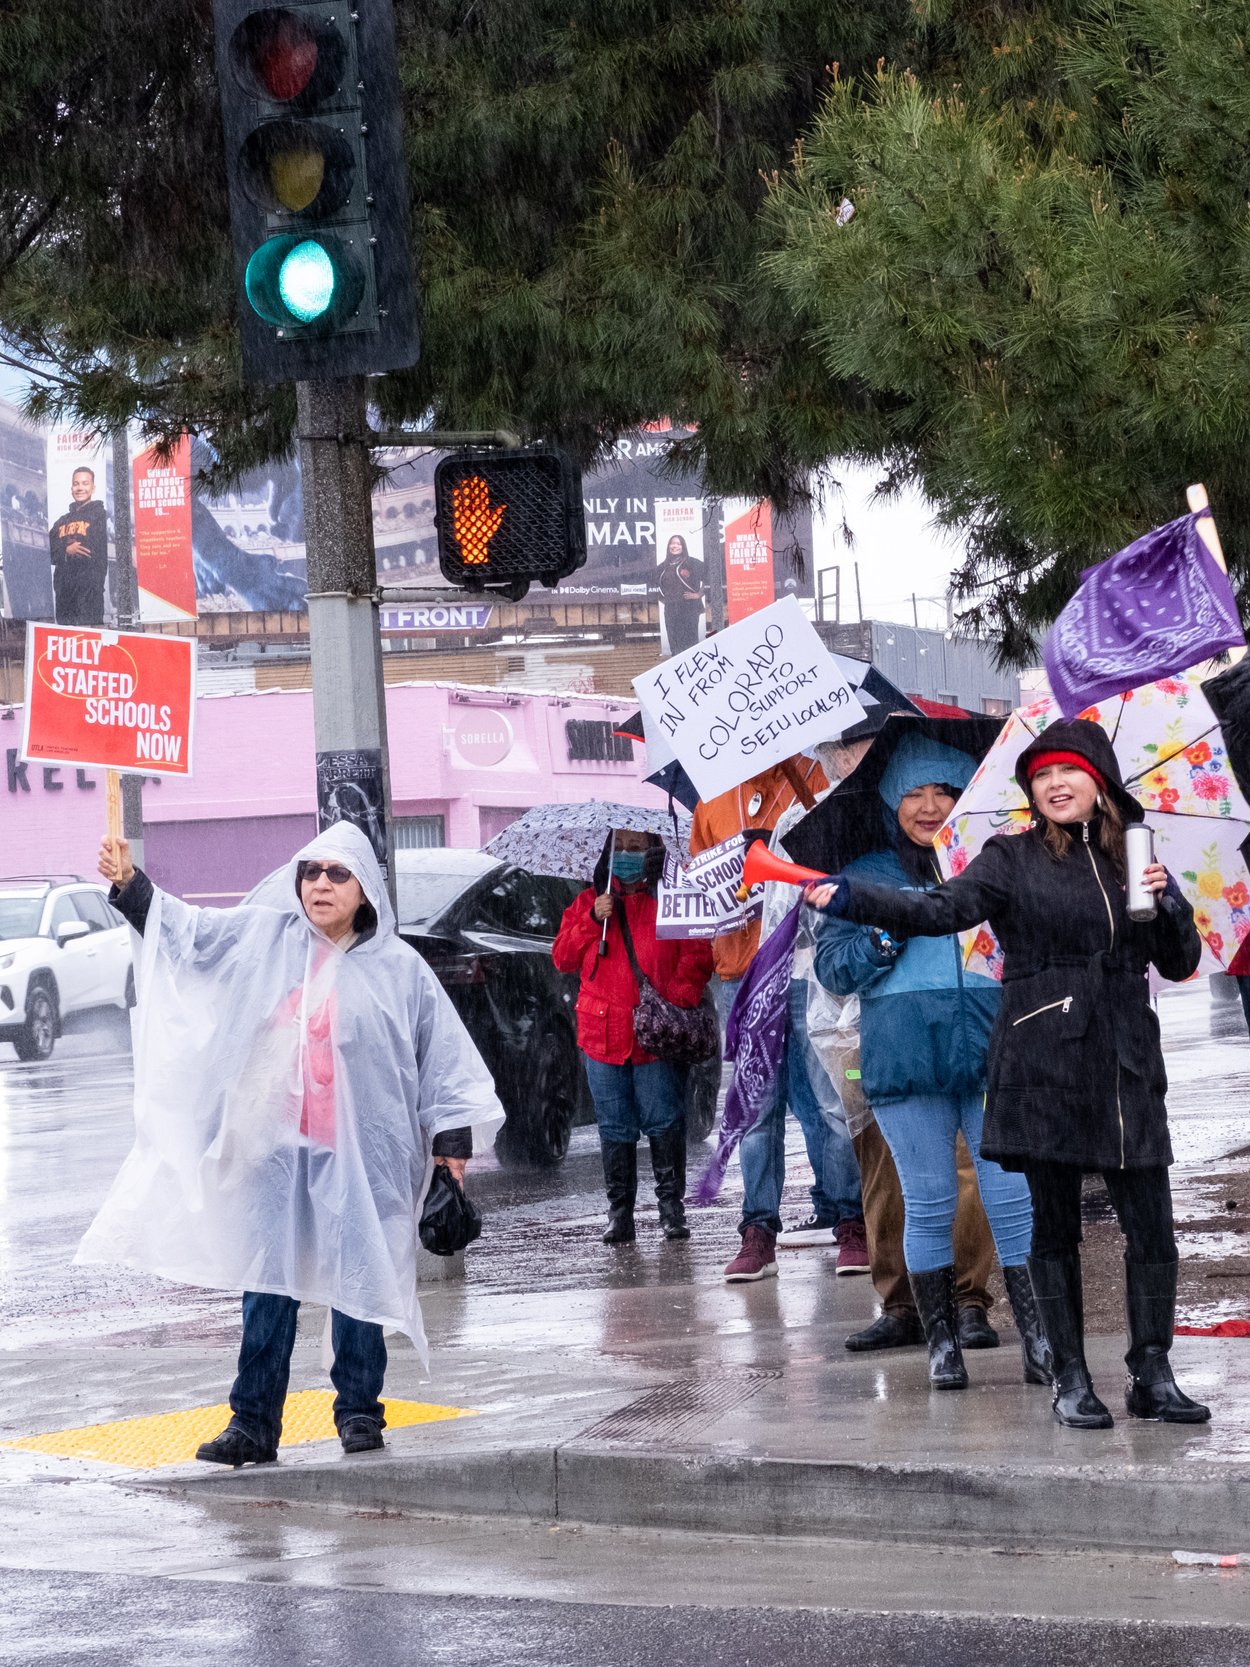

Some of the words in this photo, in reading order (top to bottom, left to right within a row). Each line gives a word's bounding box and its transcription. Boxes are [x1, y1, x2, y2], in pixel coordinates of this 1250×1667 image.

[138, 479, 157, 488] LOVE
[159, 477, 185, 487] ABOUT
[138, 486, 185, 500] FAIRFAX
[139, 500, 156, 508] HIGH
[158, 498, 185, 507] SCHOOL
[583, 498, 619, 513] NLY
[627, 497, 647, 513] IN
[663, 508, 694, 516] FAIRFAX
[587, 521, 656, 545] MAR
[730, 547, 767, 558] FAIRFAX
[570, 586, 590, 595] Dolby
[381, 607, 484, 627] TFRONT
[47, 636, 102, 665] FULLY
[52, 667, 132, 698] STAFFED
[653, 673, 670, 700] I
[674, 642, 719, 685] FLEW
[768, 662, 793, 683] TO
[659, 700, 686, 737] IN
[688, 656, 734, 706] FROM
[699, 624, 784, 760] COLORADO
[749, 664, 819, 721] SUPPORT
[85, 698, 171, 731] SCHOOLS
[741, 714, 791, 755] SEIU
[792, 698, 833, 726] LOCAL
[829, 686, 850, 707] 99
[136, 732, 181, 762] NOW
[689, 845, 723, 870] STRIKE
[725, 833, 745, 851] FOR
[661, 893, 719, 918] BETTER
